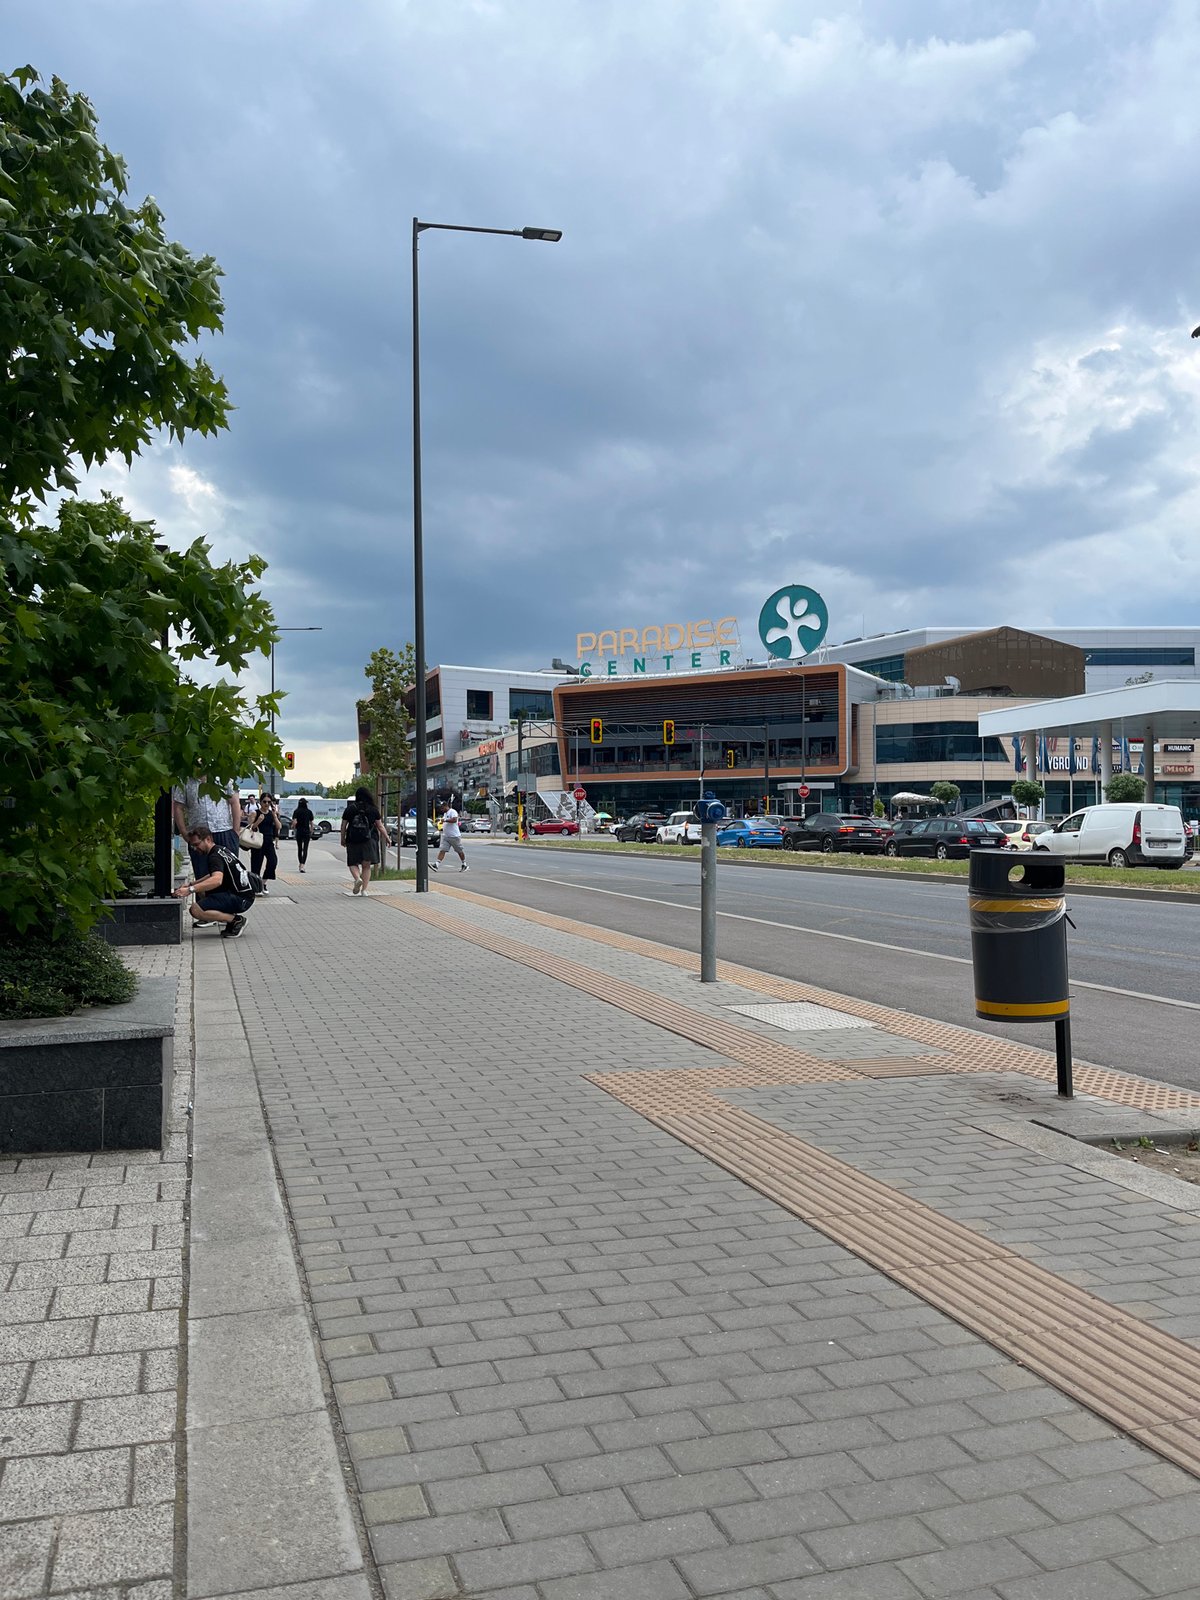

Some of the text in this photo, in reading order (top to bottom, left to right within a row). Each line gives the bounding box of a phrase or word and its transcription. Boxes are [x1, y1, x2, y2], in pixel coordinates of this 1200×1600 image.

[576, 616, 737, 659] PARADISE
[580, 650, 730, 677] CENTER
[1166, 765, 1193, 773] Miele
